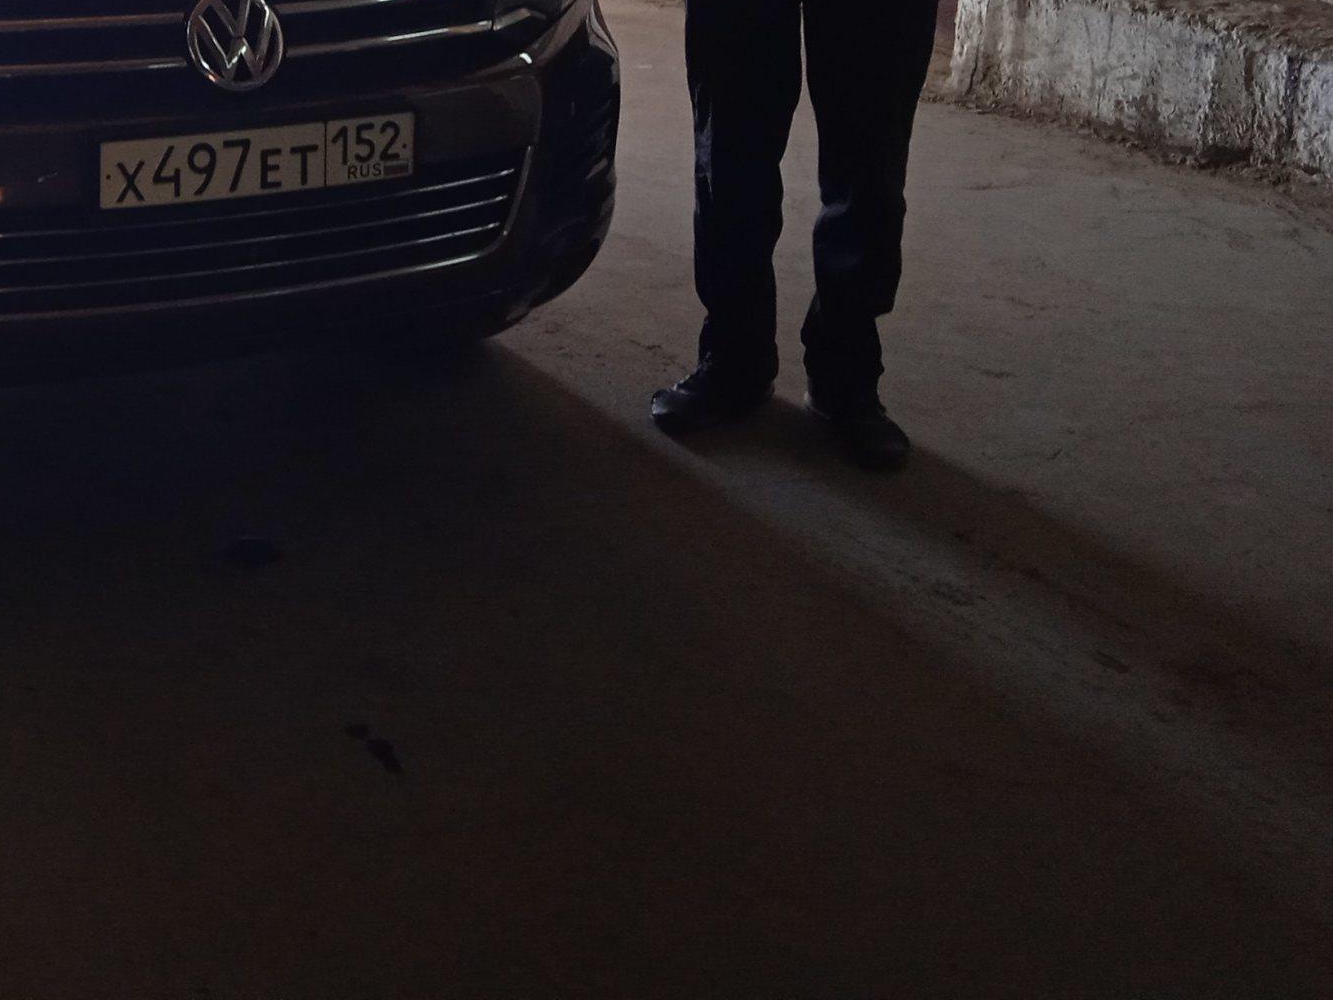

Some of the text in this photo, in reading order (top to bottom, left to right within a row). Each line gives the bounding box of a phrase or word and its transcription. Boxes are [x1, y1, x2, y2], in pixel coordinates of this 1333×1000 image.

[331, 120, 401, 166] 152
[117, 137, 319, 203] Х497ЕТ
[347, 163, 382, 180] RUS
